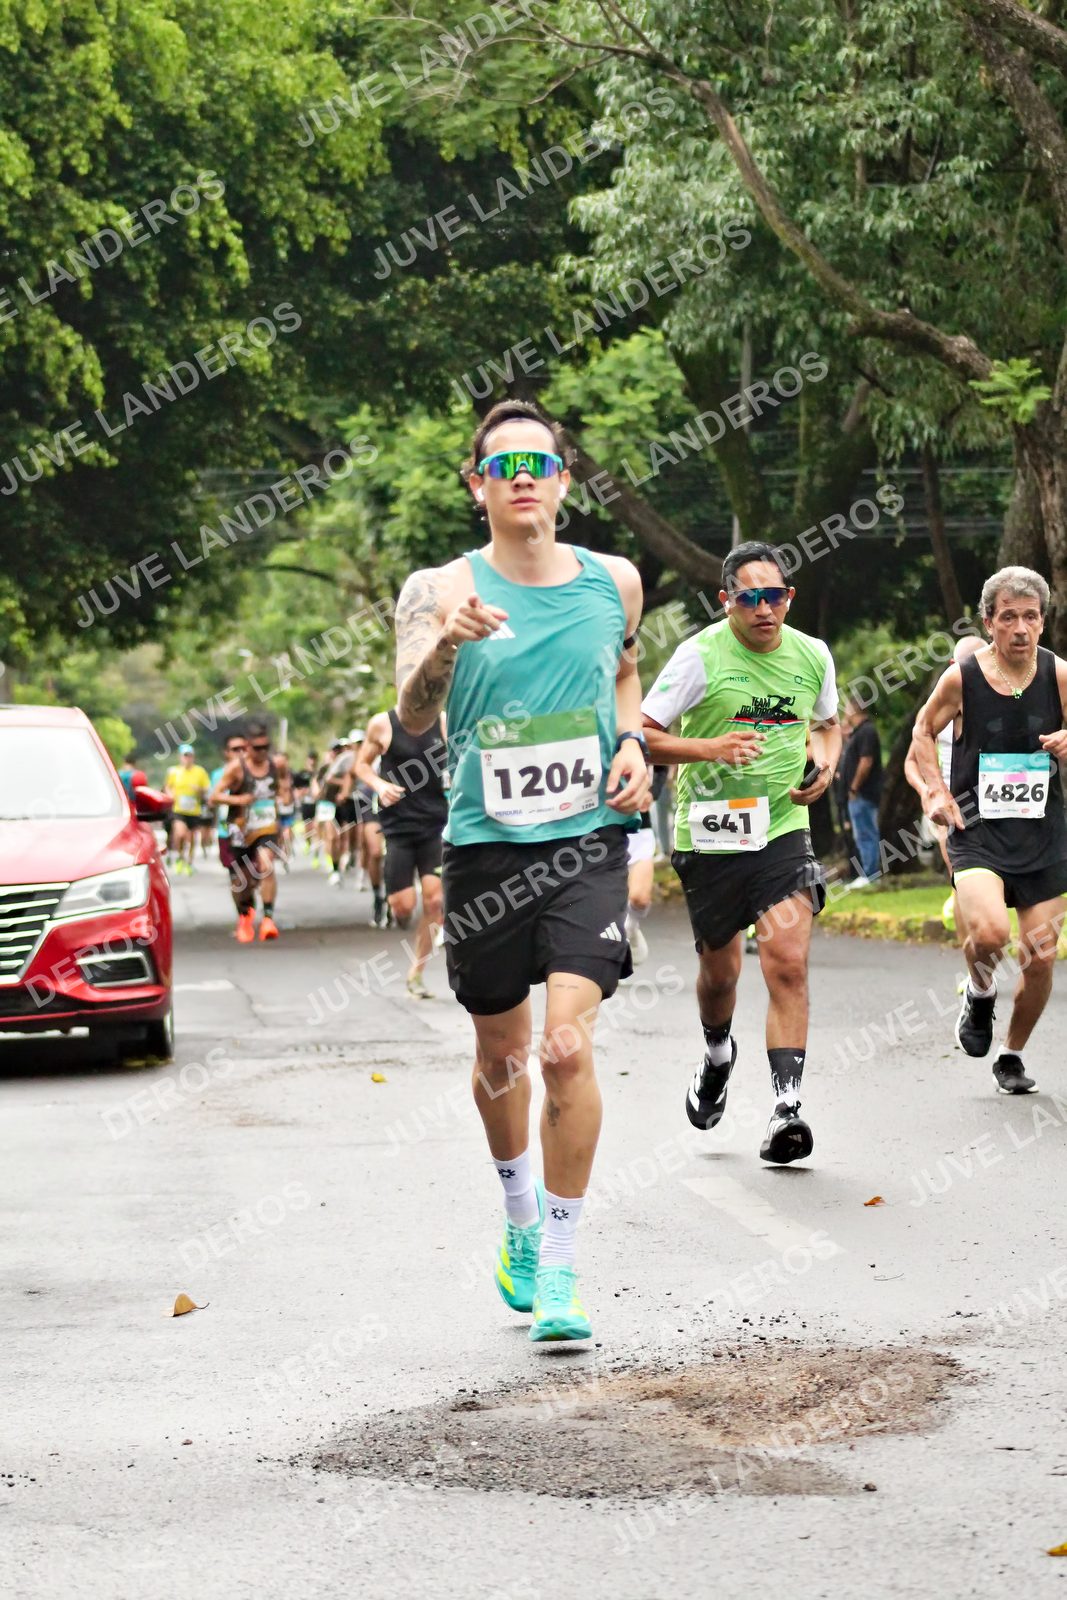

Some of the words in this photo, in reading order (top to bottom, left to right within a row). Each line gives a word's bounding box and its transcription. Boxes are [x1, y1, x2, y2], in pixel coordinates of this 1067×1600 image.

[751, 695, 771, 708] TEAM
[493, 758, 595, 800] 1204
[984, 783, 1045, 803] 4826
[702, 812, 752, 835] 641
